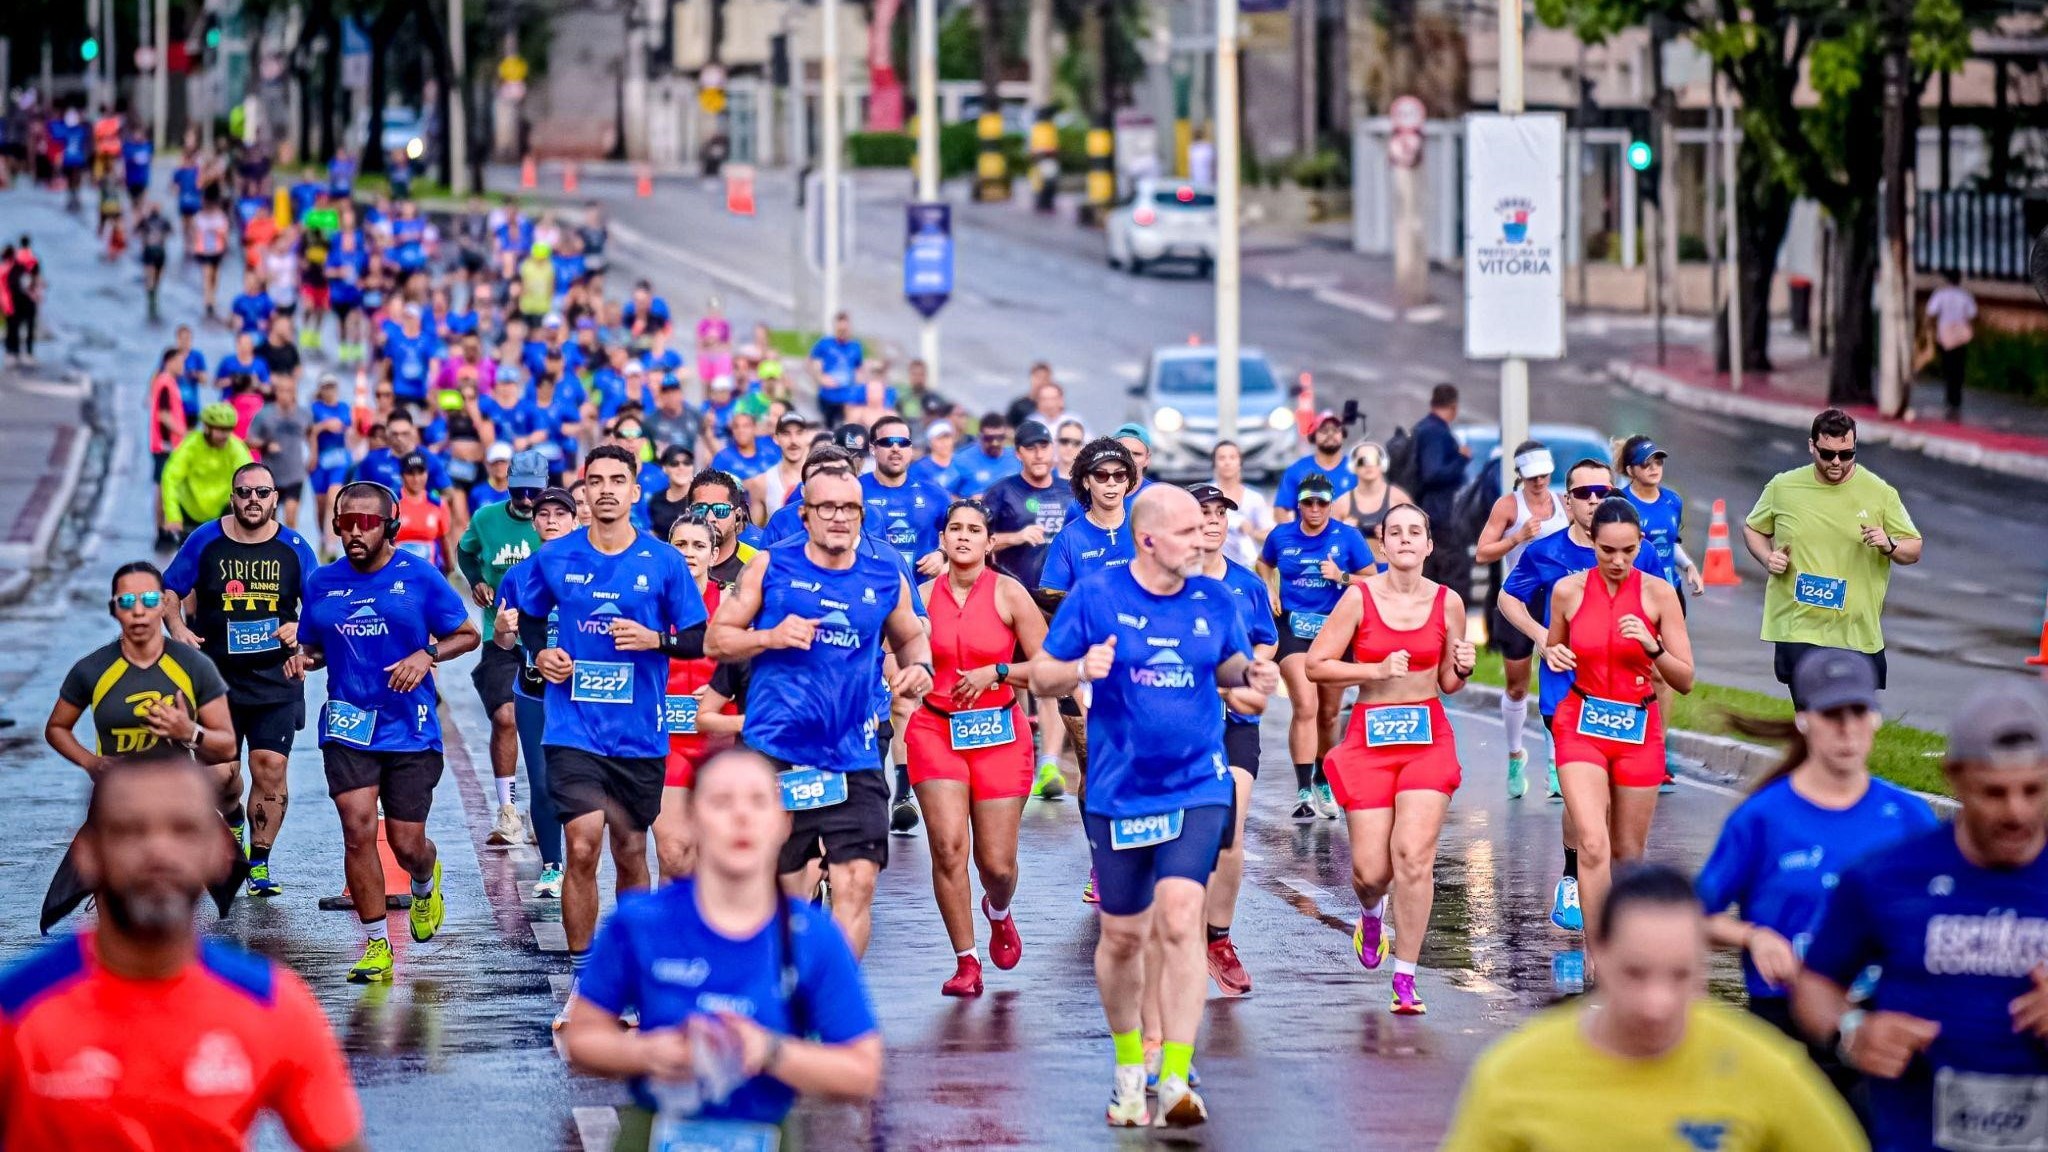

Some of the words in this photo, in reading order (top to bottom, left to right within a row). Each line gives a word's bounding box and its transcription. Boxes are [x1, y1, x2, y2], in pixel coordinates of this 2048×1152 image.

[1478, 258, 1551, 275] VITÓRIA
[1801, 584, 1834, 600] 1246
[235, 631, 270, 645] 1384
[579, 675, 628, 691] 2227
[1373, 720, 1419, 736] 2727
[1585, 710, 1635, 731] 3429
[956, 721, 1003, 738] 3426
[790, 782, 825, 801] 138
